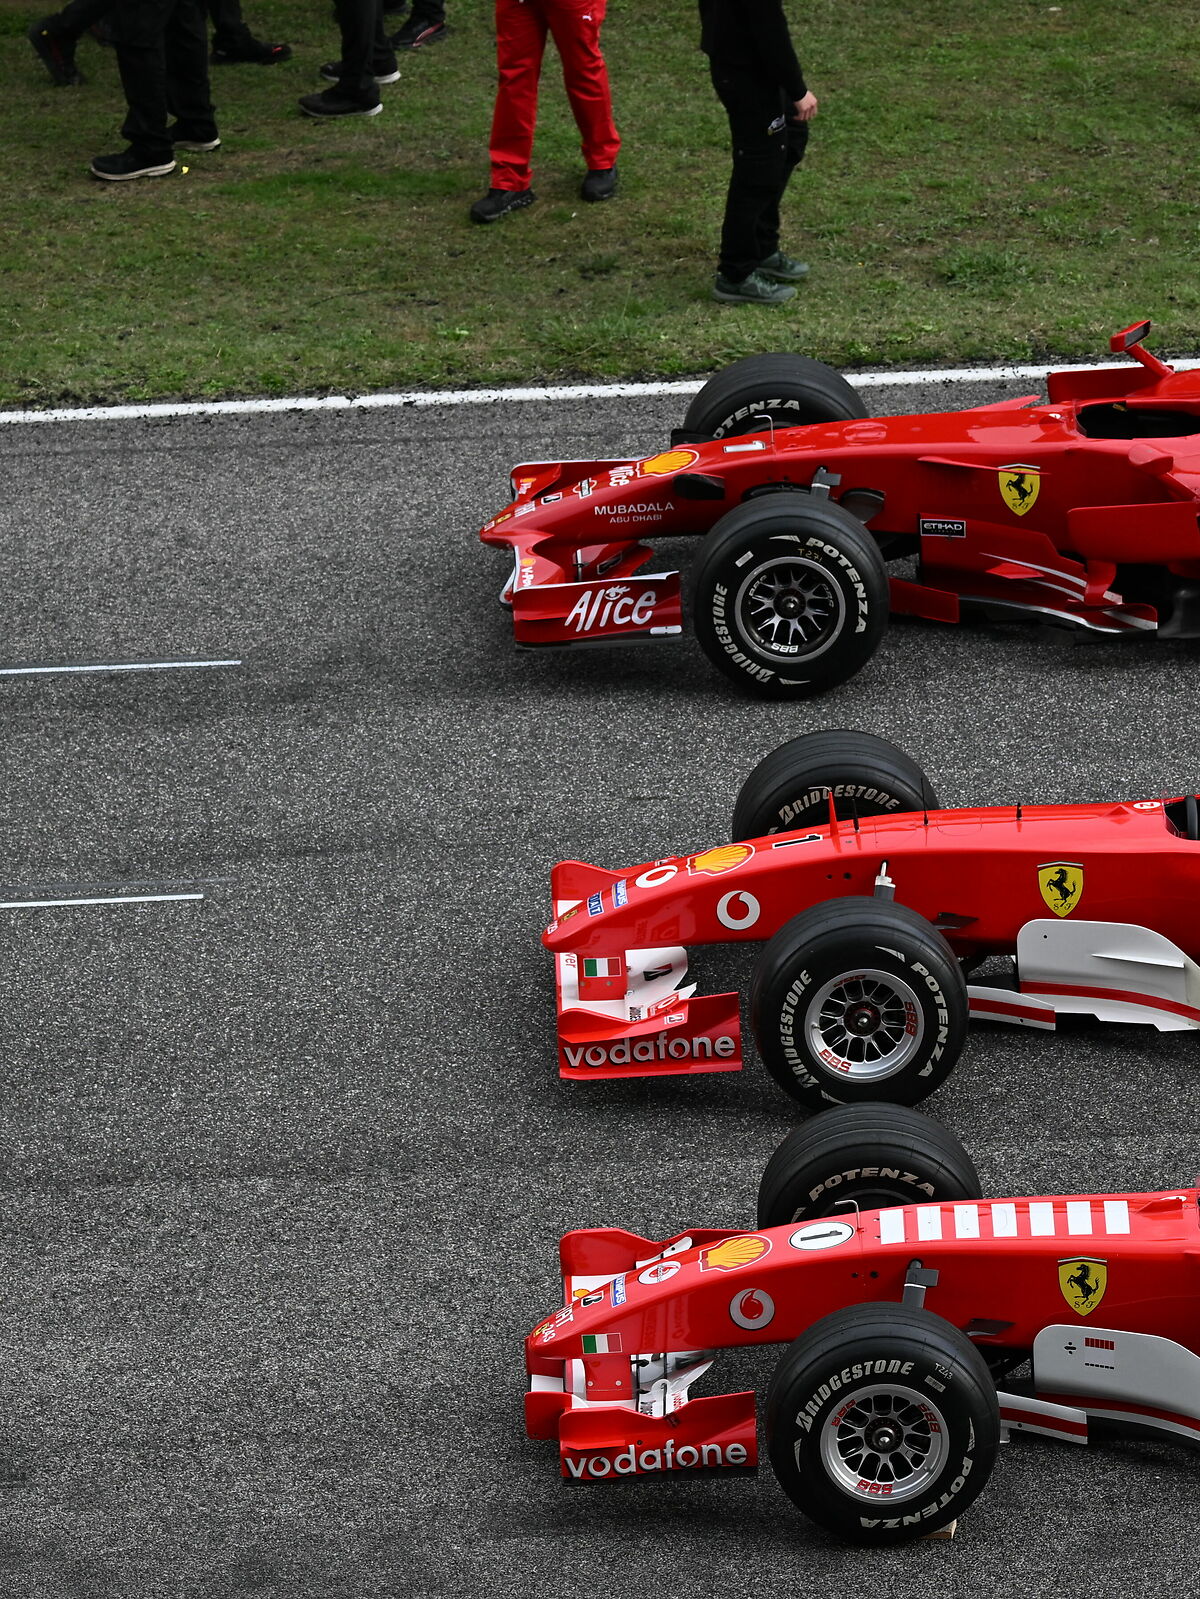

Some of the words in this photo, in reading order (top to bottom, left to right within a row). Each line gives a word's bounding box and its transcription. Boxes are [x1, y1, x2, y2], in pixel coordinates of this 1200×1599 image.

[712, 399, 800, 440] OTENZA
[594, 501, 675, 515] MUBADALA
[609, 516, 630, 524] ABU
[806, 537, 868, 633] POTENZA
[564, 585, 656, 632] Alice
[713, 583, 776, 683] BRIDGESTONE
[771, 642, 799, 653] BBS
[779, 969, 820, 1089] BRIDGESTONE
[910, 961, 949, 1077] POTENZA
[564, 1032, 736, 1067] vodafone
[818, 1048, 853, 1073] BBS
[809, 1167, 935, 1201] POTENZA
[795, 1359, 915, 1433] BRIDGESTONE
[565, 1439, 748, 1478] vodafone
[856, 1478, 893, 1495] BBS
[860, 1457, 974, 1529] POTENZA
